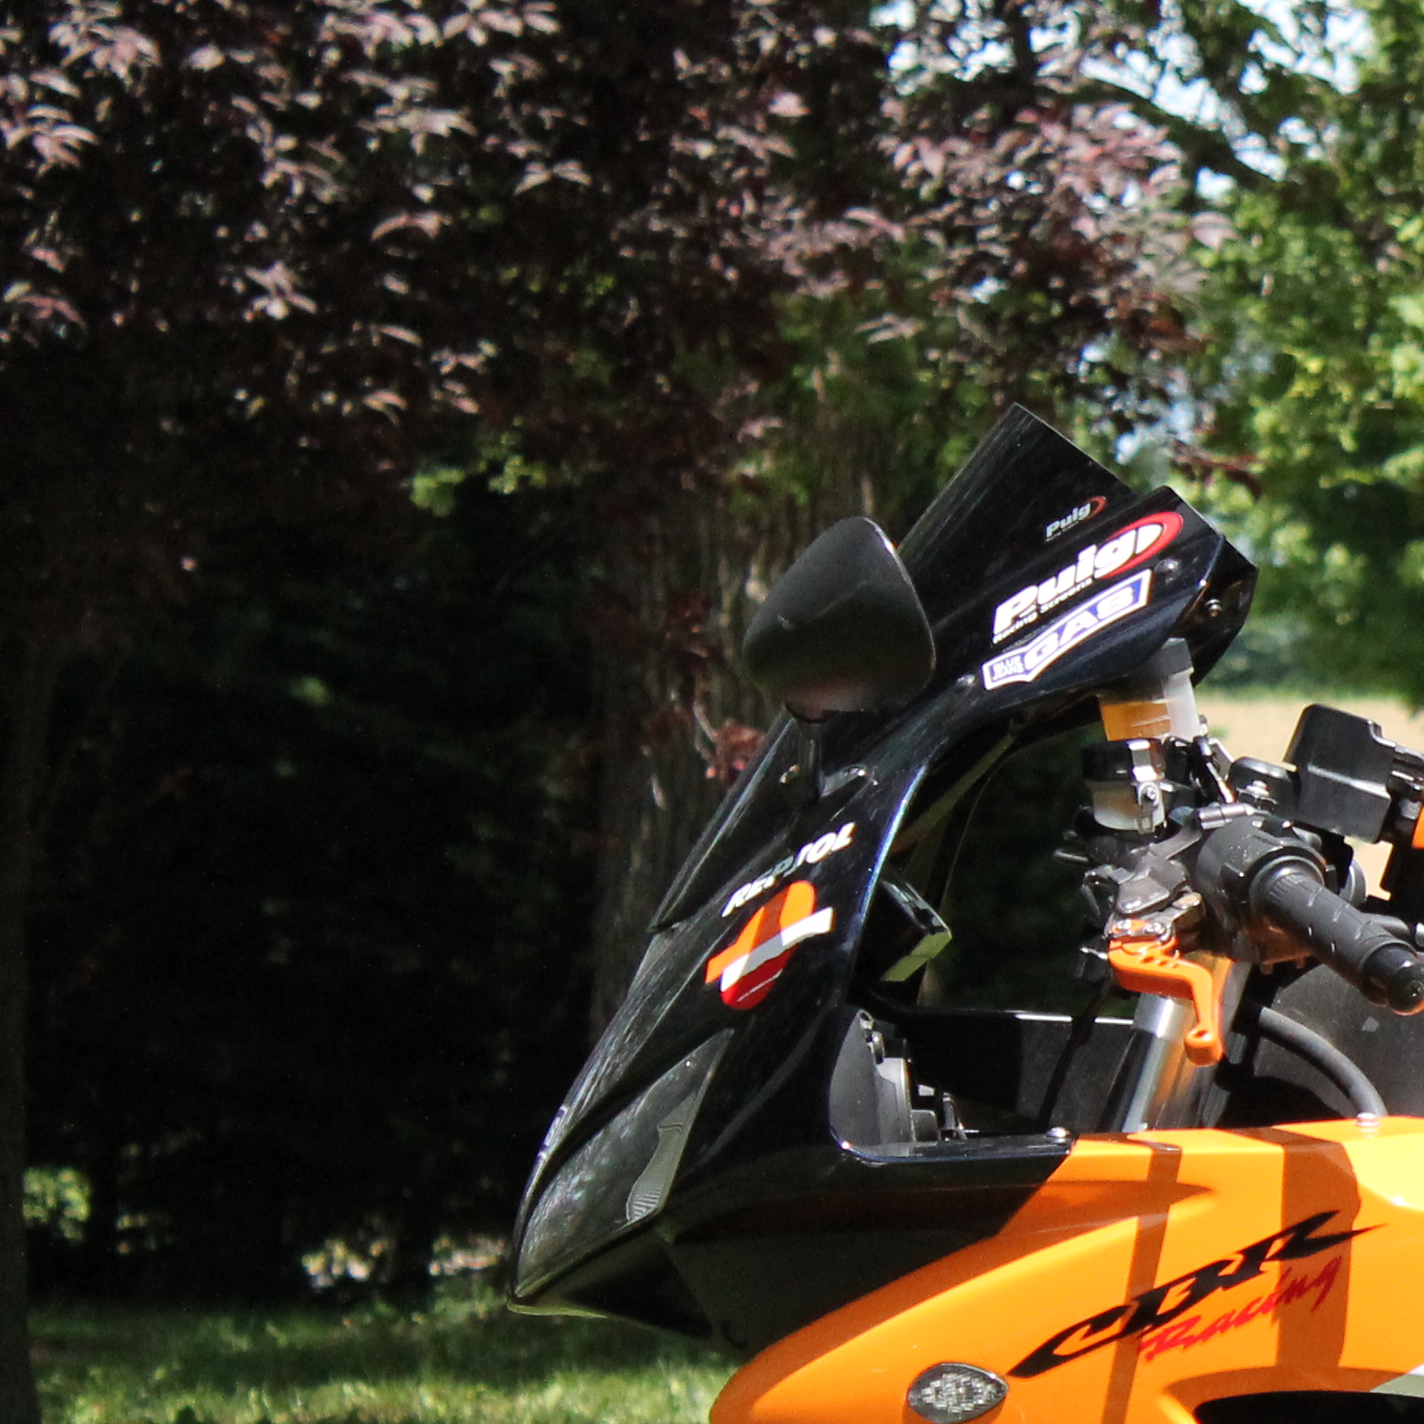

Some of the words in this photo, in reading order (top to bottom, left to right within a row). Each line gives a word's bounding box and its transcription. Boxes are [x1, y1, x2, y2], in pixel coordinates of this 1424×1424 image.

[1046, 503, 1091, 538] Puig
[992, 528, 1138, 637] Puig
[722, 821, 857, 919] REPSOL
[1006, 1209, 1388, 1379] CBR
[1139, 1255, 1343, 1362] Racing
